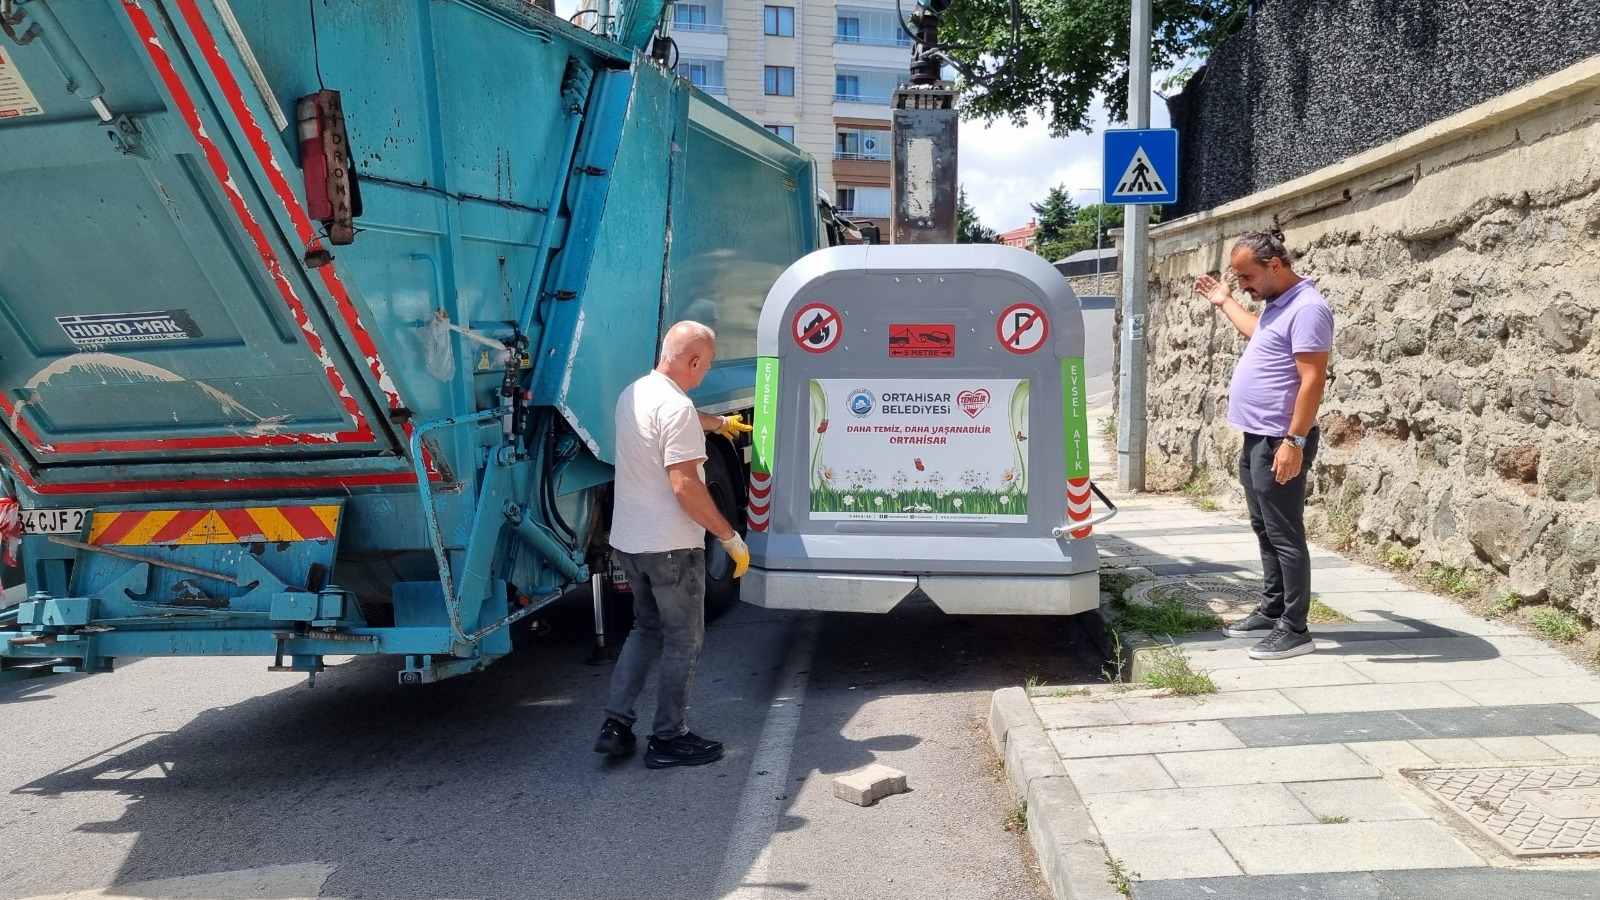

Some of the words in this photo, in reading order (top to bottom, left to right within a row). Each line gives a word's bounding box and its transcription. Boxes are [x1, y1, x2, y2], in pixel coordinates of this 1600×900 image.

[67, 319, 182, 337] HIDRO-MAK
[763, 364, 771, 414] EVSEL
[1071, 365, 1079, 418] EVSEL
[874, 424, 902, 434] TEMİZ,
[889, 435, 947, 445] ORTAHİSAR
[1073, 429, 1082, 471] ATIK
[39, 511, 68, 532] CJF
[74, 510, 91, 531] 2
